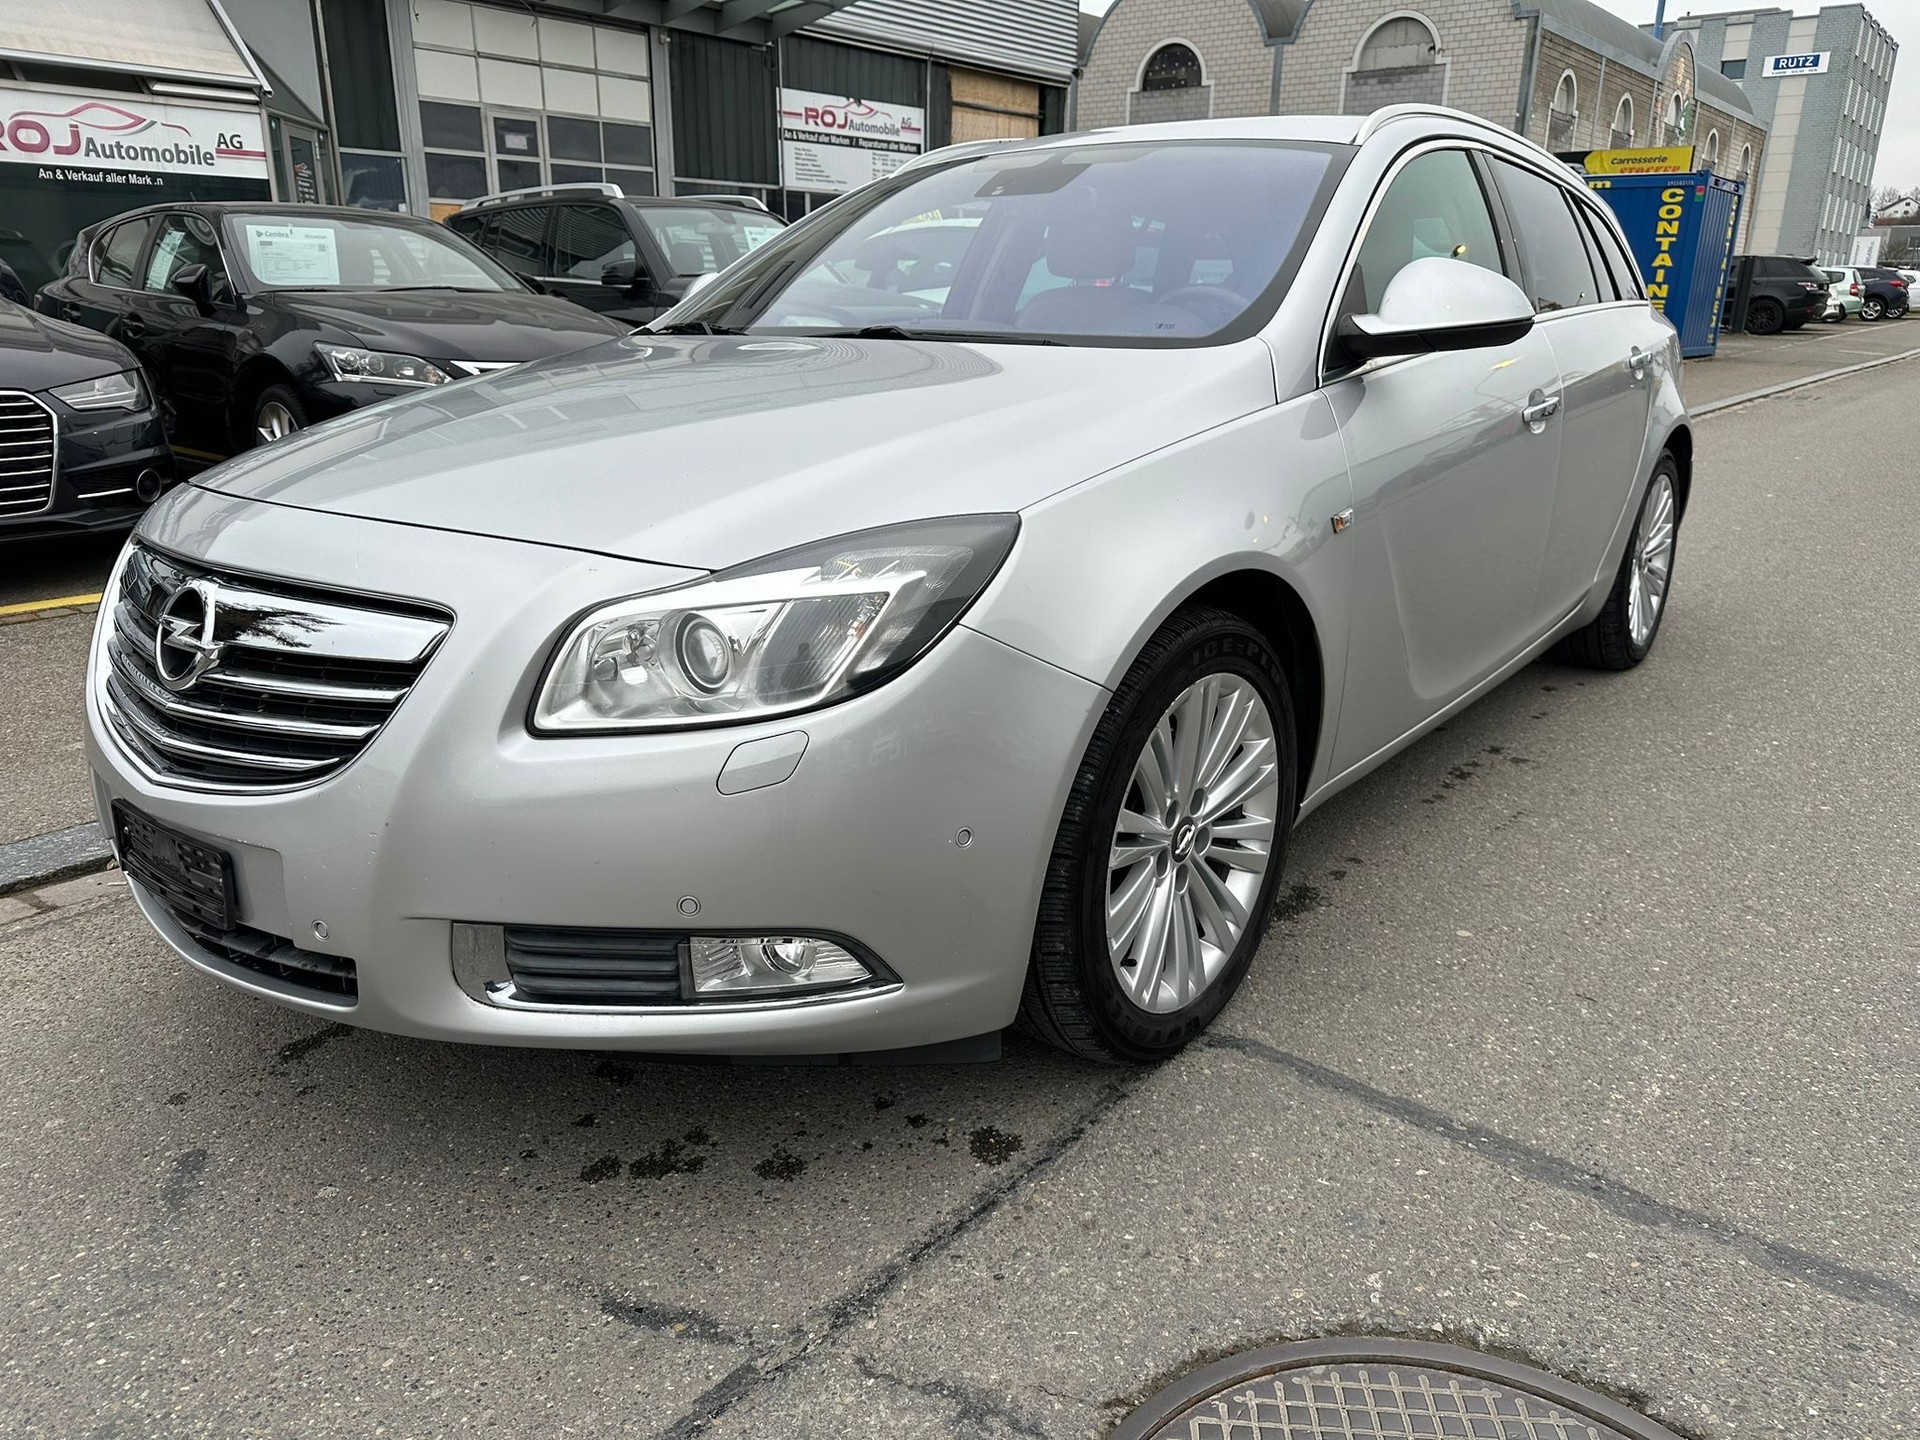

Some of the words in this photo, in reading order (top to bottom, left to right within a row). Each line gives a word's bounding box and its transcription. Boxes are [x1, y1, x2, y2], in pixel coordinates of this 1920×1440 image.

[1778, 56, 1815, 68] RUTZ
[804, 106, 849, 129] ROJ
[849, 119, 900, 137] Automobile
[901, 117, 912, 126] AG
[0, 119, 81, 156] OJ
[84, 137, 215, 166] Automobile
[217, 133, 243, 149] AG
[784, 130, 792, 138] An
[793, 130, 798, 139] &
[797, 131, 818, 142] Verkauf
[38, 168, 53, 179] An
[55, 168, 64, 180] &
[64, 169, 104, 183] Verkauf
[105, 172, 127, 184] aller
